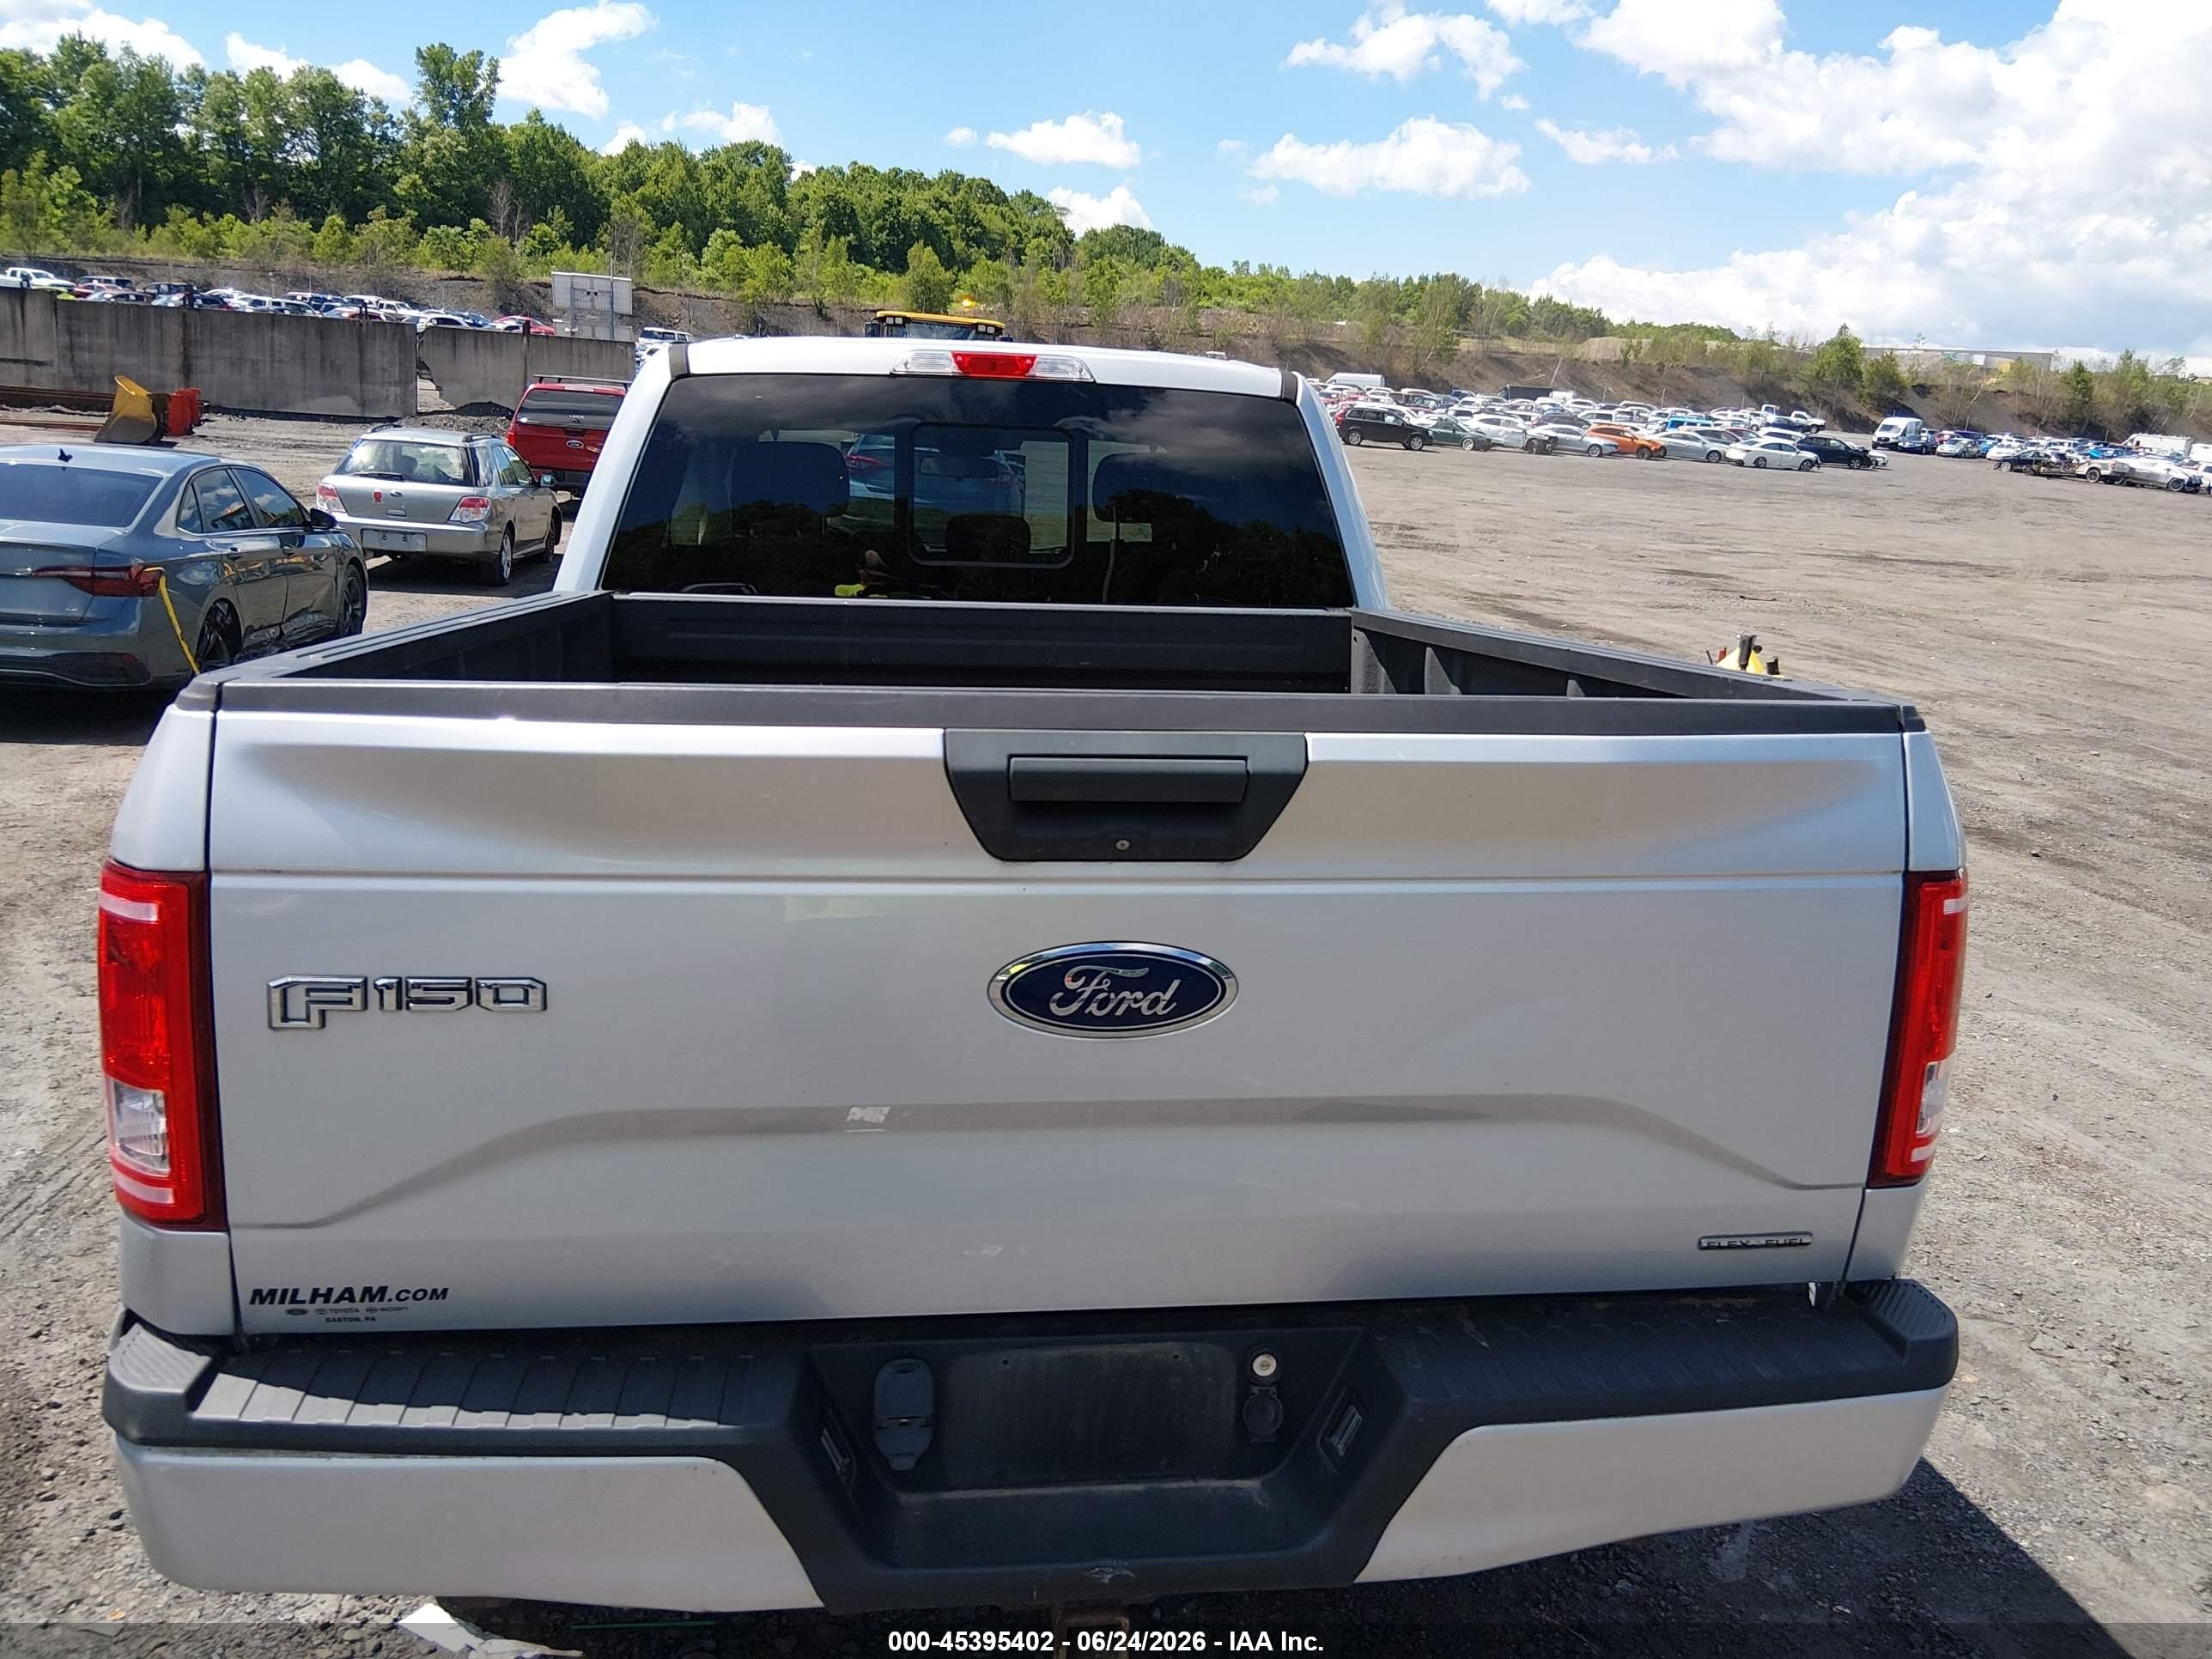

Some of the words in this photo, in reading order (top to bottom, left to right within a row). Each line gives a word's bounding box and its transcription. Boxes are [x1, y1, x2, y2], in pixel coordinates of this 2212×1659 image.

[267, 975, 548, 1030] F150
[1049, 964, 1182, 1017] Ford
[249, 1285, 449, 1305] MILHAM.COM
